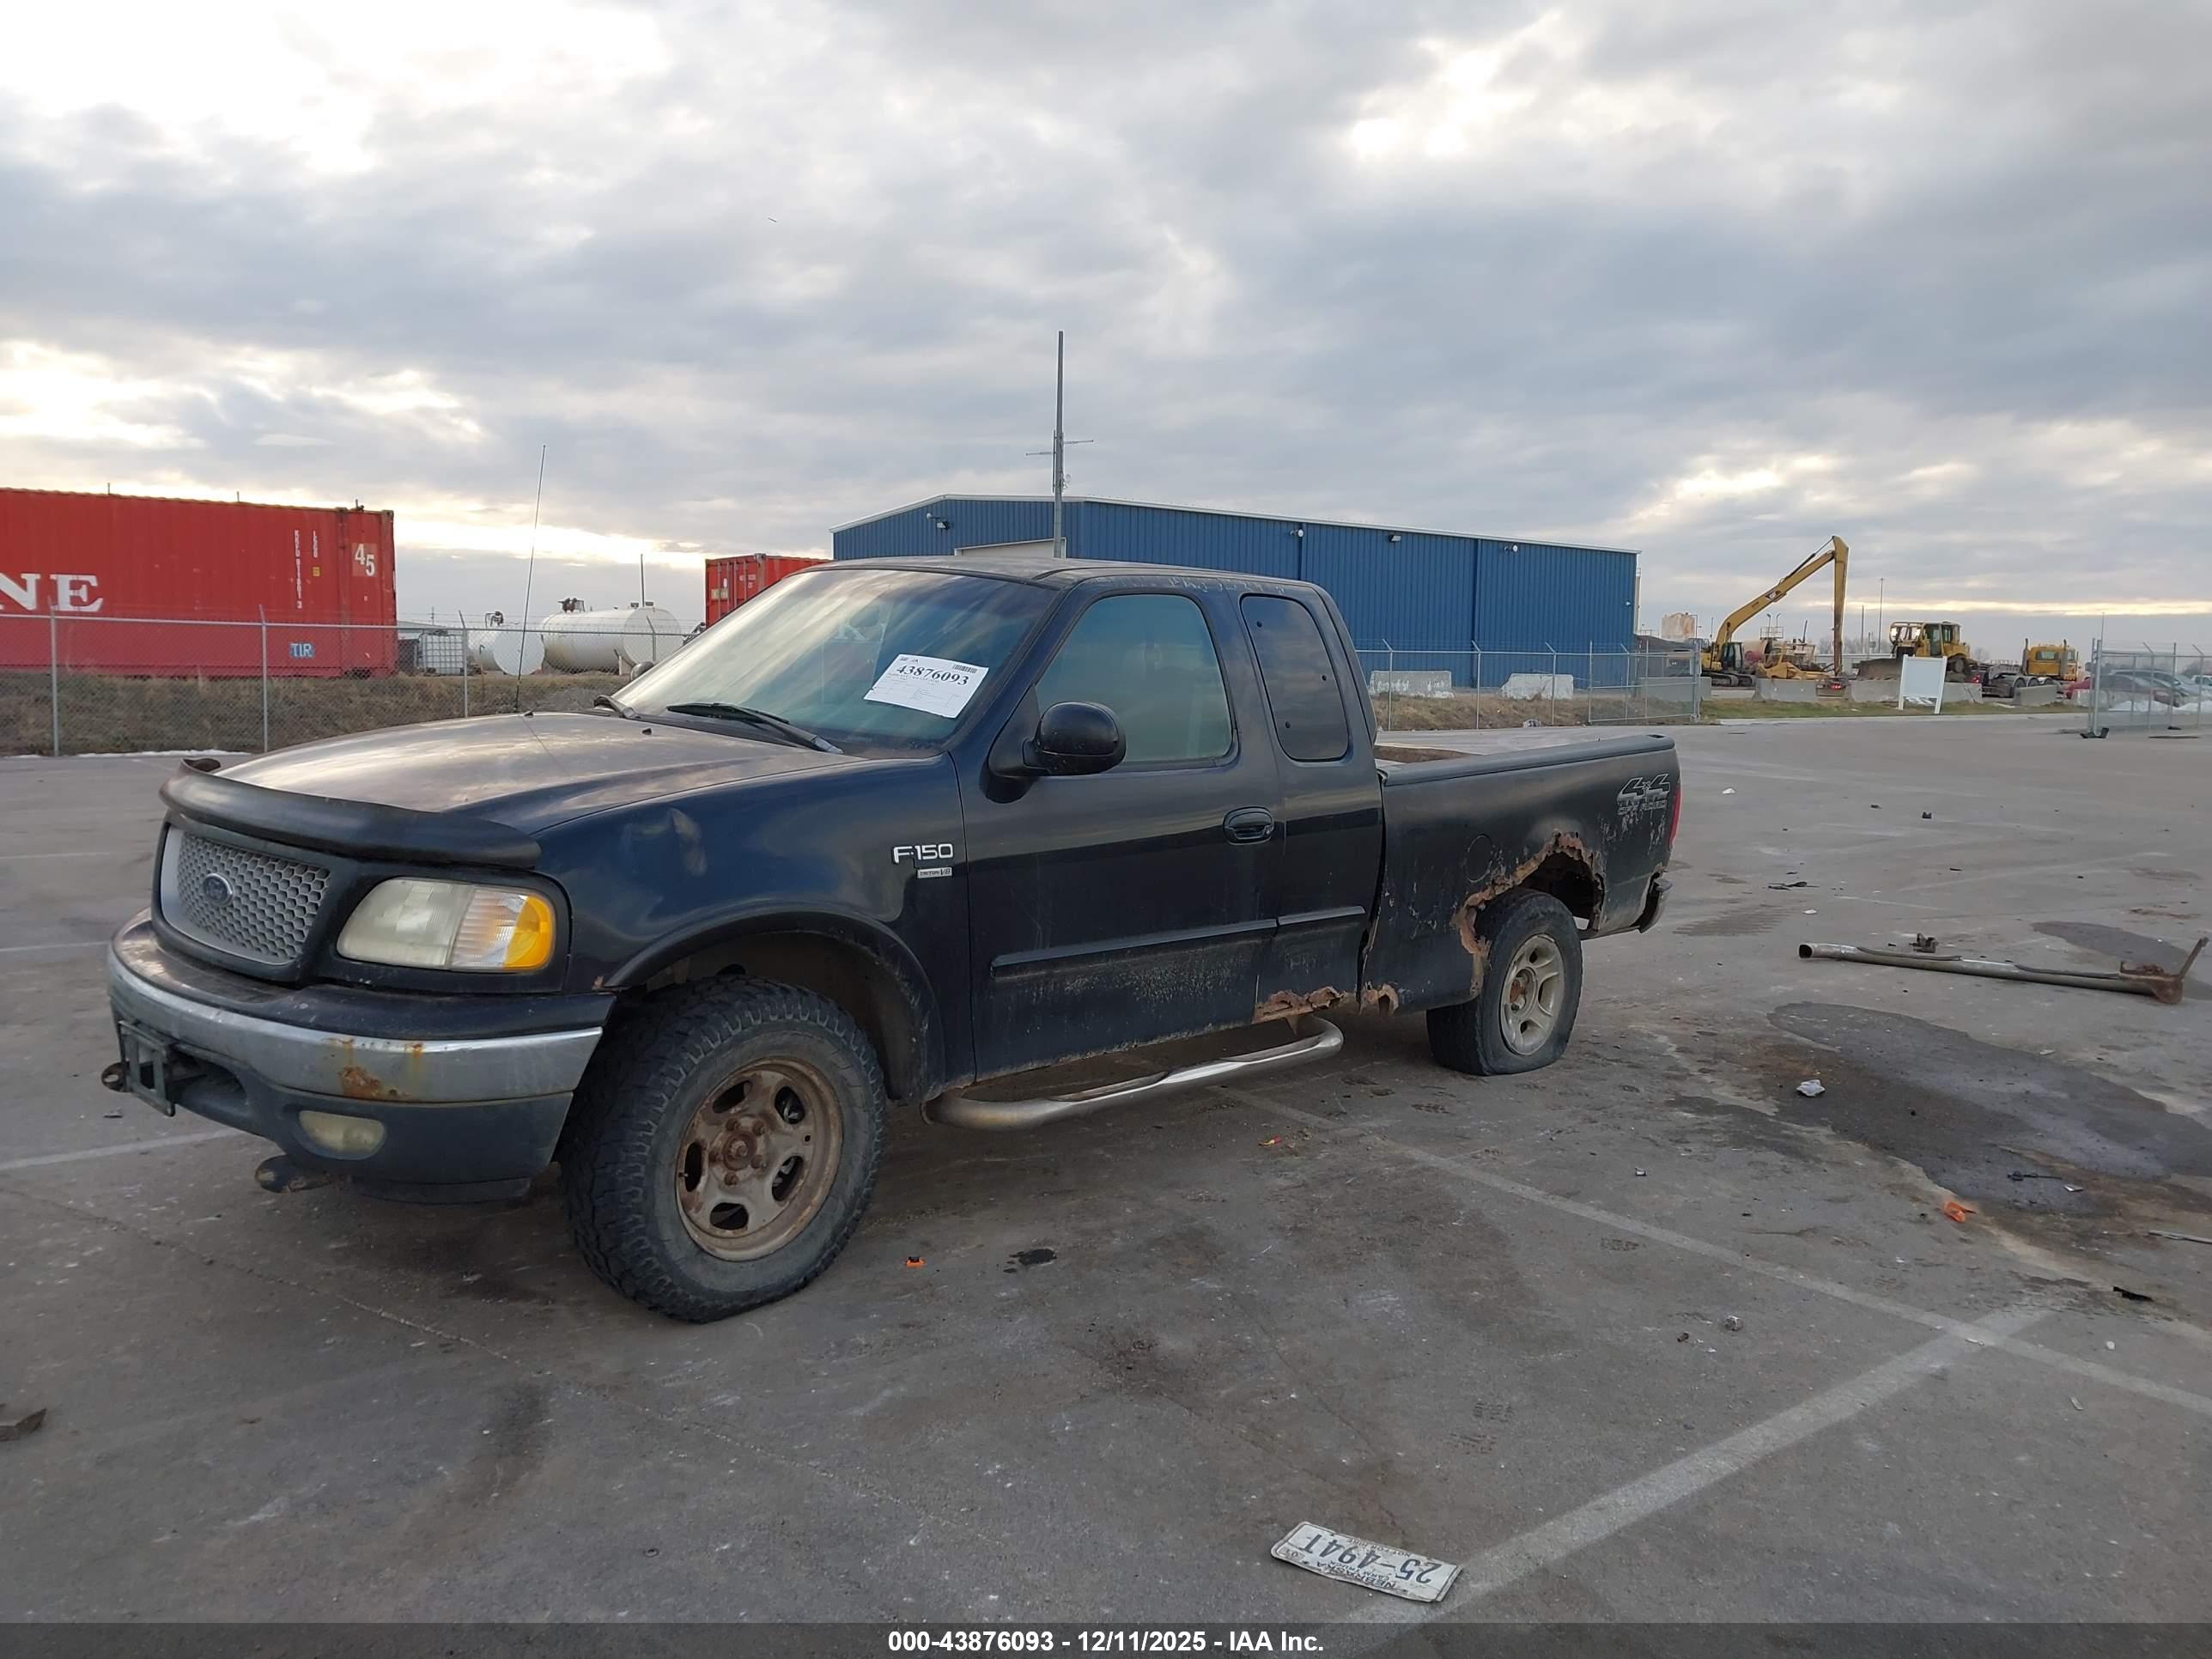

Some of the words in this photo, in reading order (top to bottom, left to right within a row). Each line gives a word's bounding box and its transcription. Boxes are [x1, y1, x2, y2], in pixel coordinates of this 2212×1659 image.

[355, 543, 375, 576] 45
[290, 642, 313, 658] TIR
[896, 665, 969, 686] 43876093
[1316, 1560, 1397, 1589] NEBRASKA
